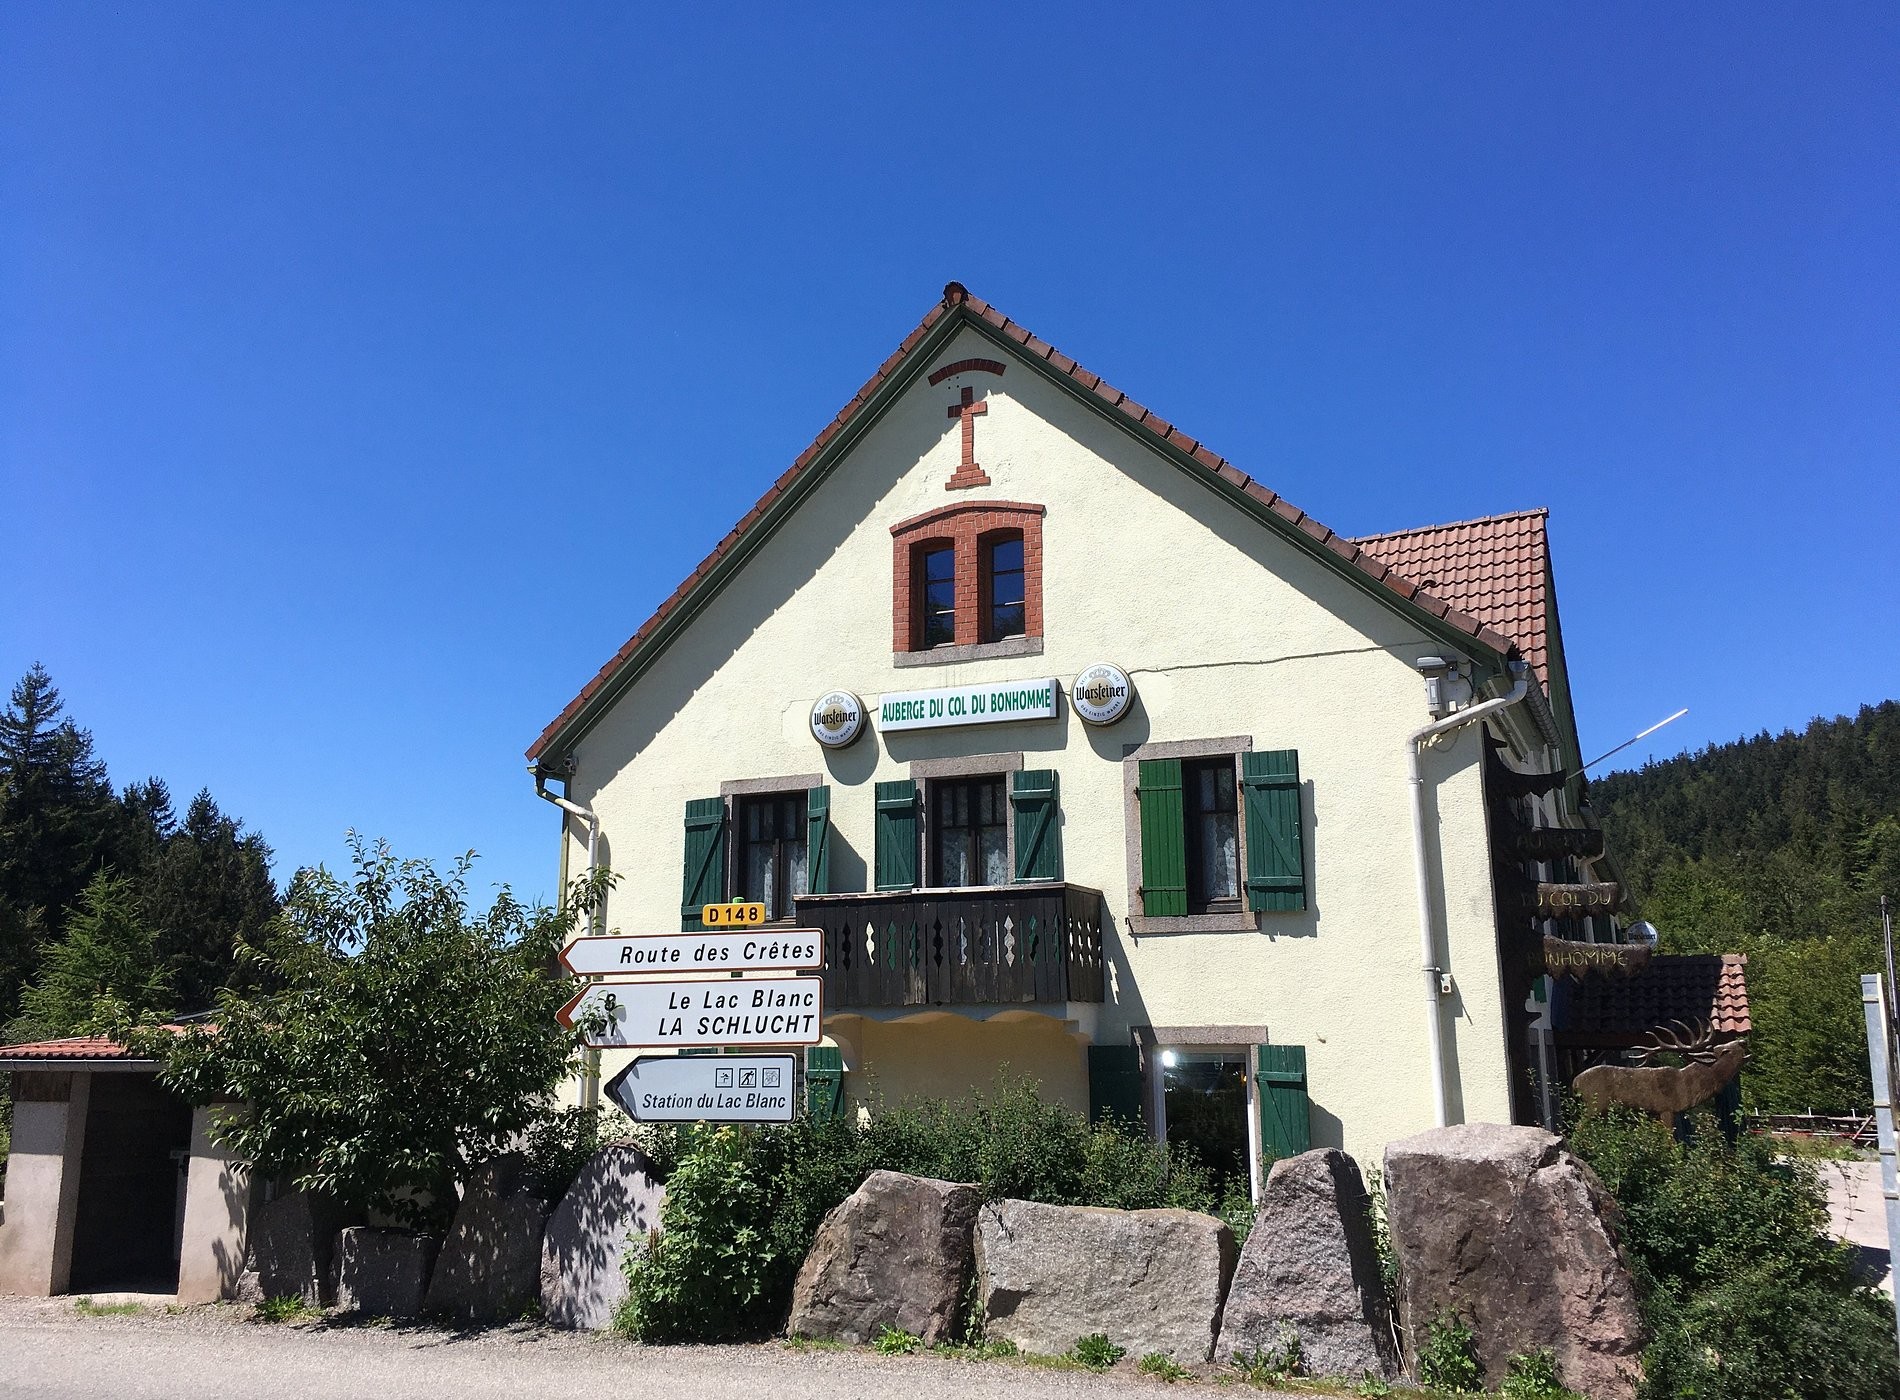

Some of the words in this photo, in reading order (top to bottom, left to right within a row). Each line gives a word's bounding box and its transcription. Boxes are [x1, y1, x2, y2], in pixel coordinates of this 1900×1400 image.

[1076, 683, 1125, 701] Warsteiner
[881, 700, 925, 722] AUBERGE
[929, 698, 943, 718] DU
[948, 695, 967, 716] COL
[971, 694, 986, 715] DU
[990, 688, 1051, 713] BONHOMME
[814, 708, 857, 726] Warsteiner
[1549, 891, 1582, 906] COL
[1588, 890, 1611, 906] DU
[709, 908, 719, 923] D
[725, 906, 758, 922] 148
[620, 946, 681, 964] Route
[693, 943, 730, 962] des
[743, 941, 815, 961] Crêtes
[604, 993, 616, 1011] 8
[669, 992, 691, 1010] Le
[703, 990, 739, 1009] Lac
[751, 989, 814, 1008] Blanc
[658, 1017, 682, 1036] LA
[697, 1014, 815, 1036] SCHLUCHT
[642, 1093, 693, 1109] Station
[697, 1093, 714, 1109] du
[717, 1093, 742, 1109] Lac
[745, 1092, 786, 1109] Blanc
